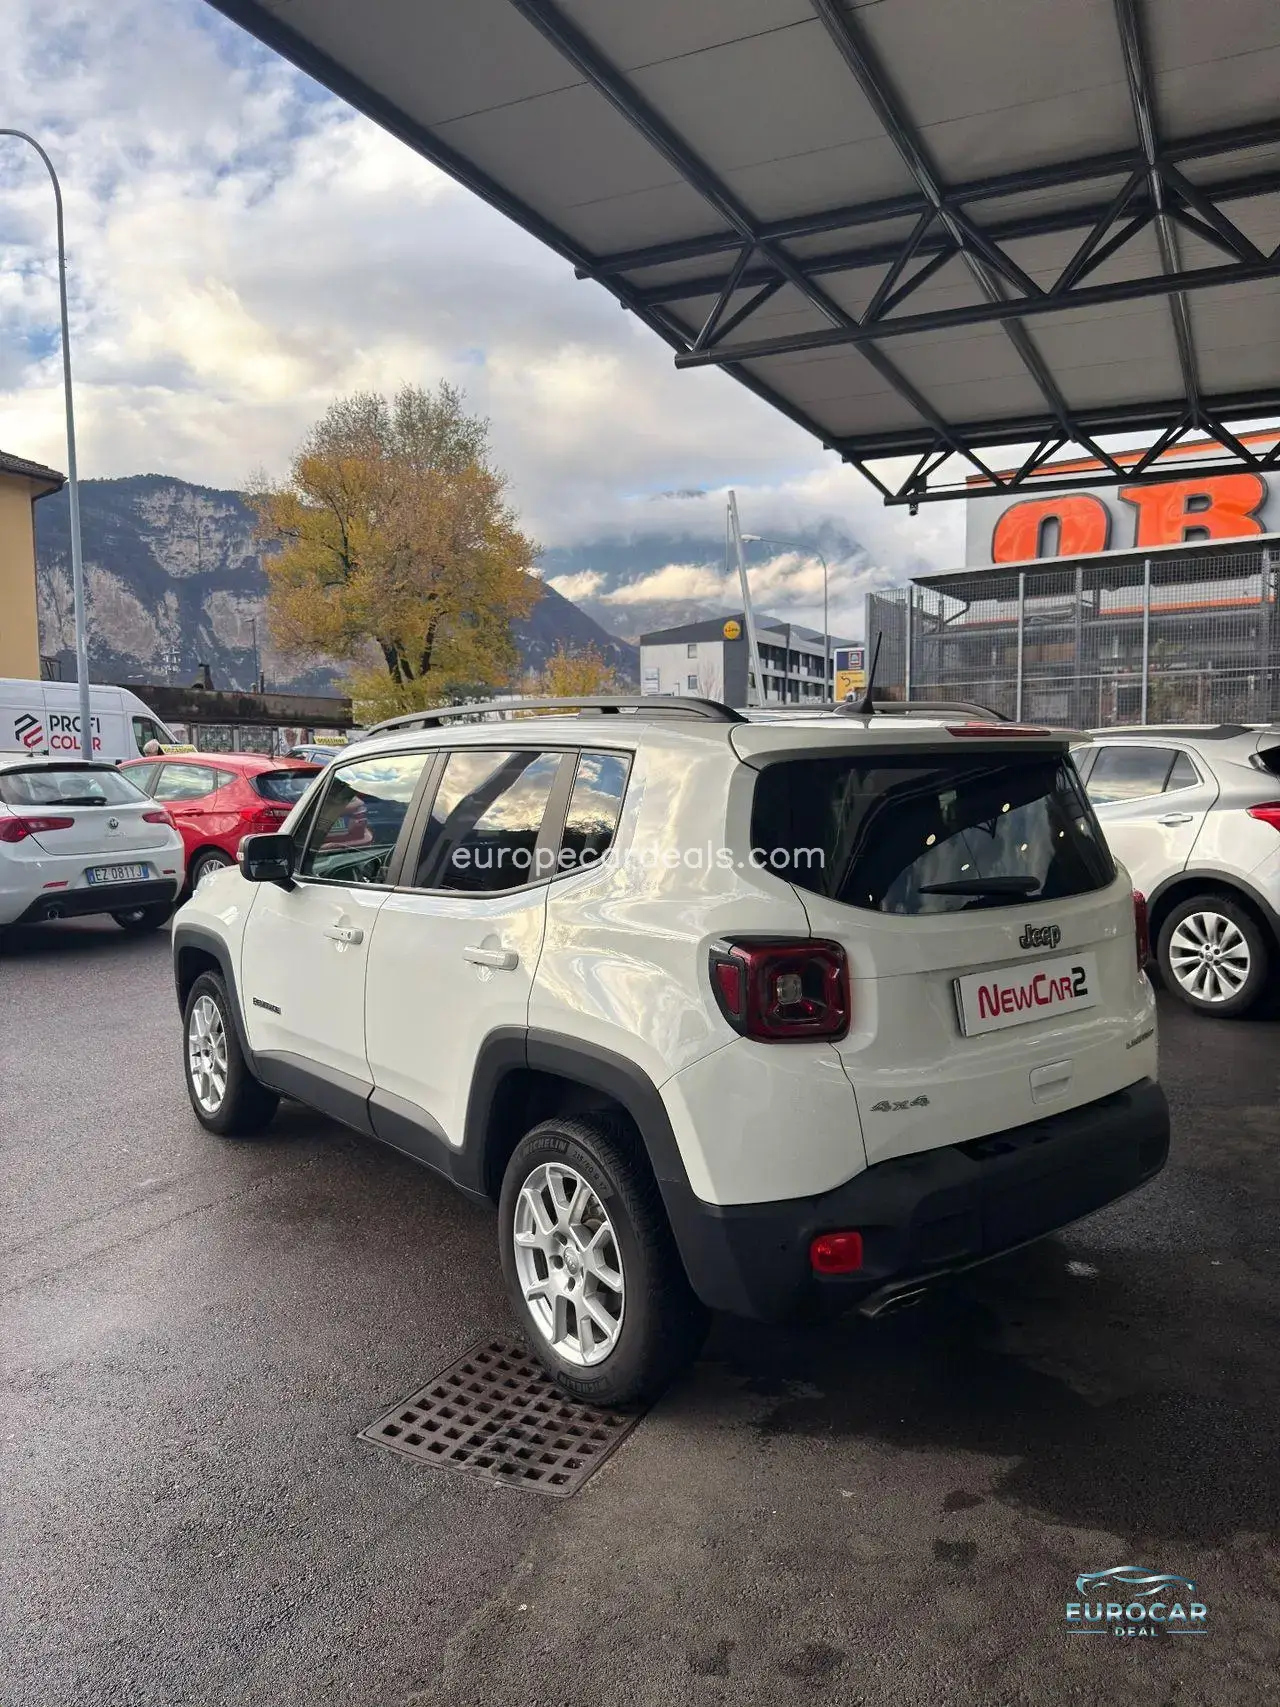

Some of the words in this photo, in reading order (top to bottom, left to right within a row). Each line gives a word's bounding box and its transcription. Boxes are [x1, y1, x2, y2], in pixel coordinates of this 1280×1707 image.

[50, 735, 101, 751] COLR
[94, 867, 109, 881] EZ
[1019, 924, 1061, 948] Jeep
